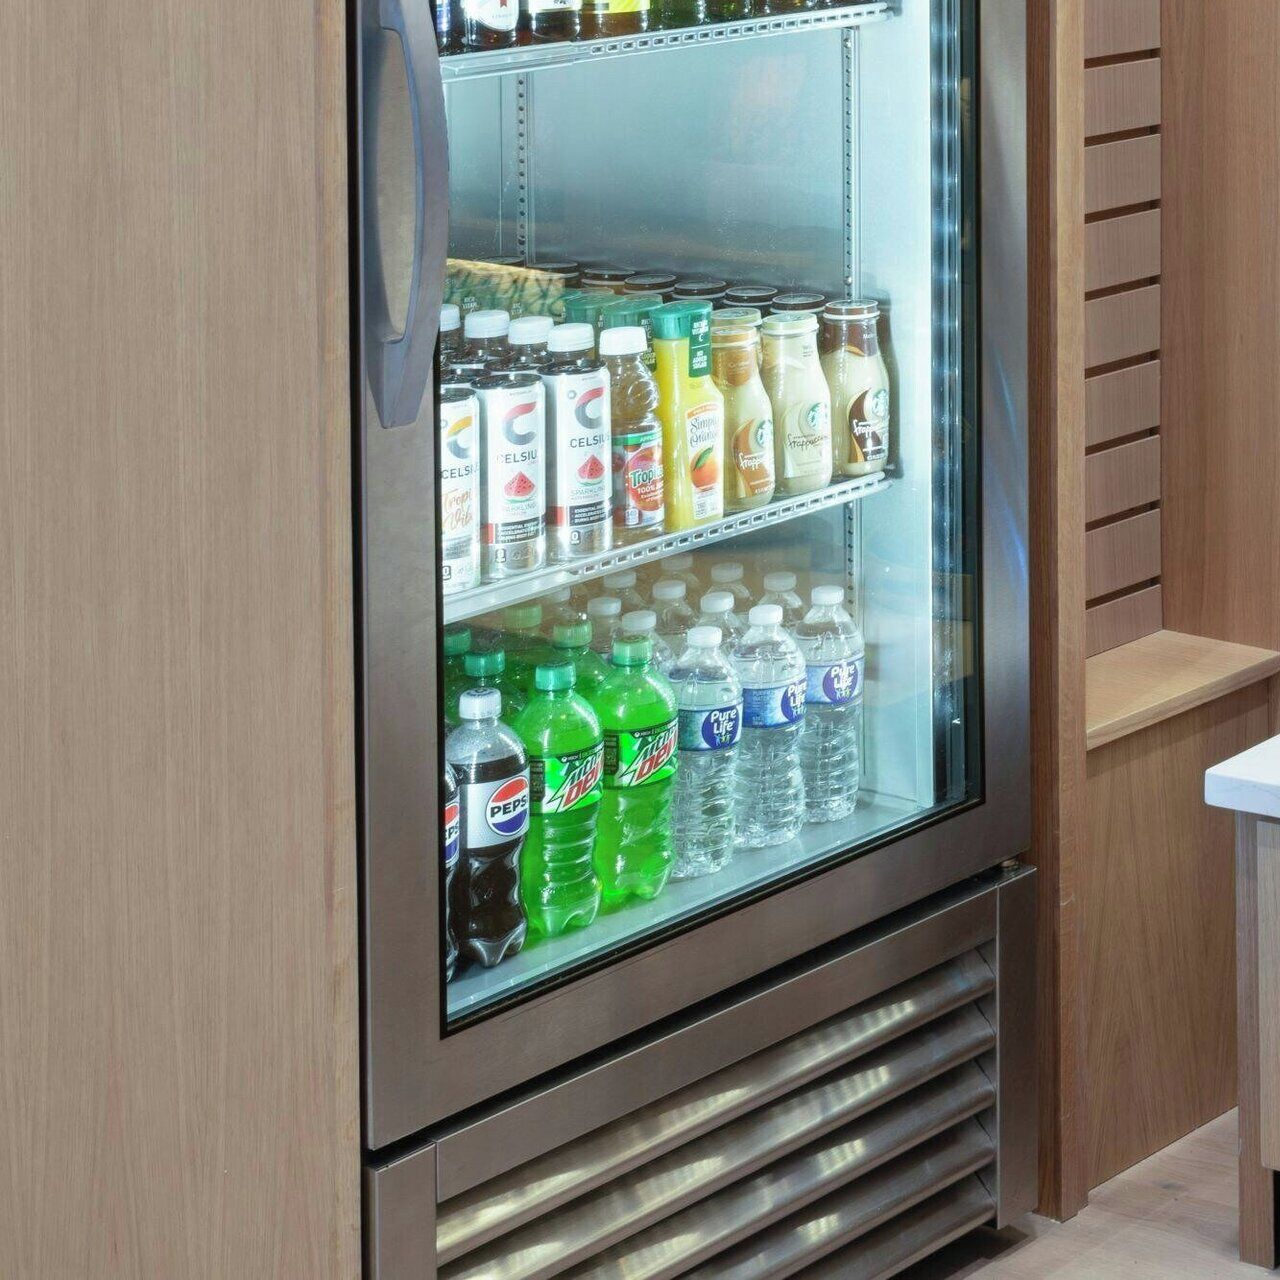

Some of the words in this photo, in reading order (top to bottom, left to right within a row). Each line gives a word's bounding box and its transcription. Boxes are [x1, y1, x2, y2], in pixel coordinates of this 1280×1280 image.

[830, 665, 855, 679] Pure
[833, 676, 854, 692] Life
[710, 708, 737, 723] Pure
[713, 719, 734, 735] Life
